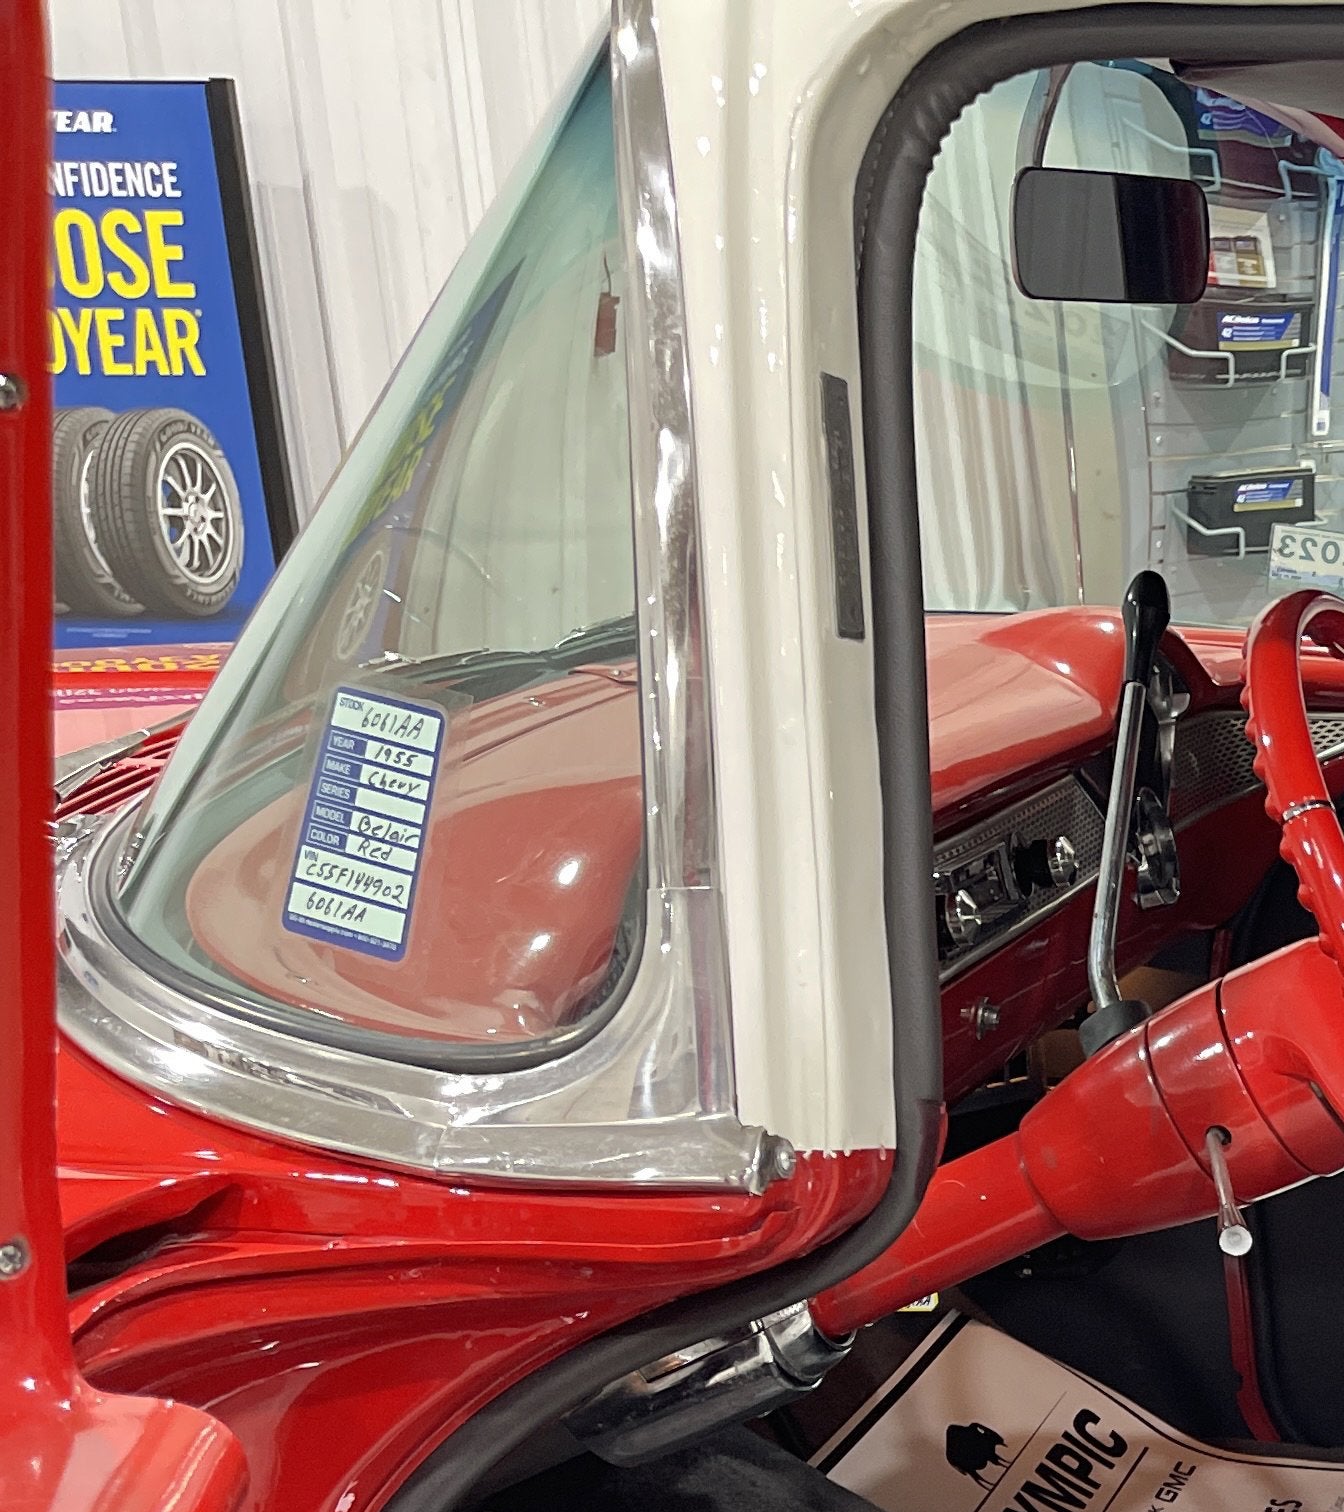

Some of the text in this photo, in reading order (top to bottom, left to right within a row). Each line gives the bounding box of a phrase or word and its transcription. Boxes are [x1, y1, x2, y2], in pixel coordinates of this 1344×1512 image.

[340, 697, 364, 712] STOCK
[361, 707, 425, 740] 6061AA
[333, 735, 355, 751] YEAR
[374, 745, 418, 768] 1955
[325, 758, 351, 776] MAKE
[319, 782, 351, 800] SERIES
[315, 805, 345, 824] MODEL
[310, 828, 340, 847] COLOR
[357, 839, 393, 862] Red
[306, 891, 367, 923] 6061AA
[1154, 1460, 1197, 1504] GMC
